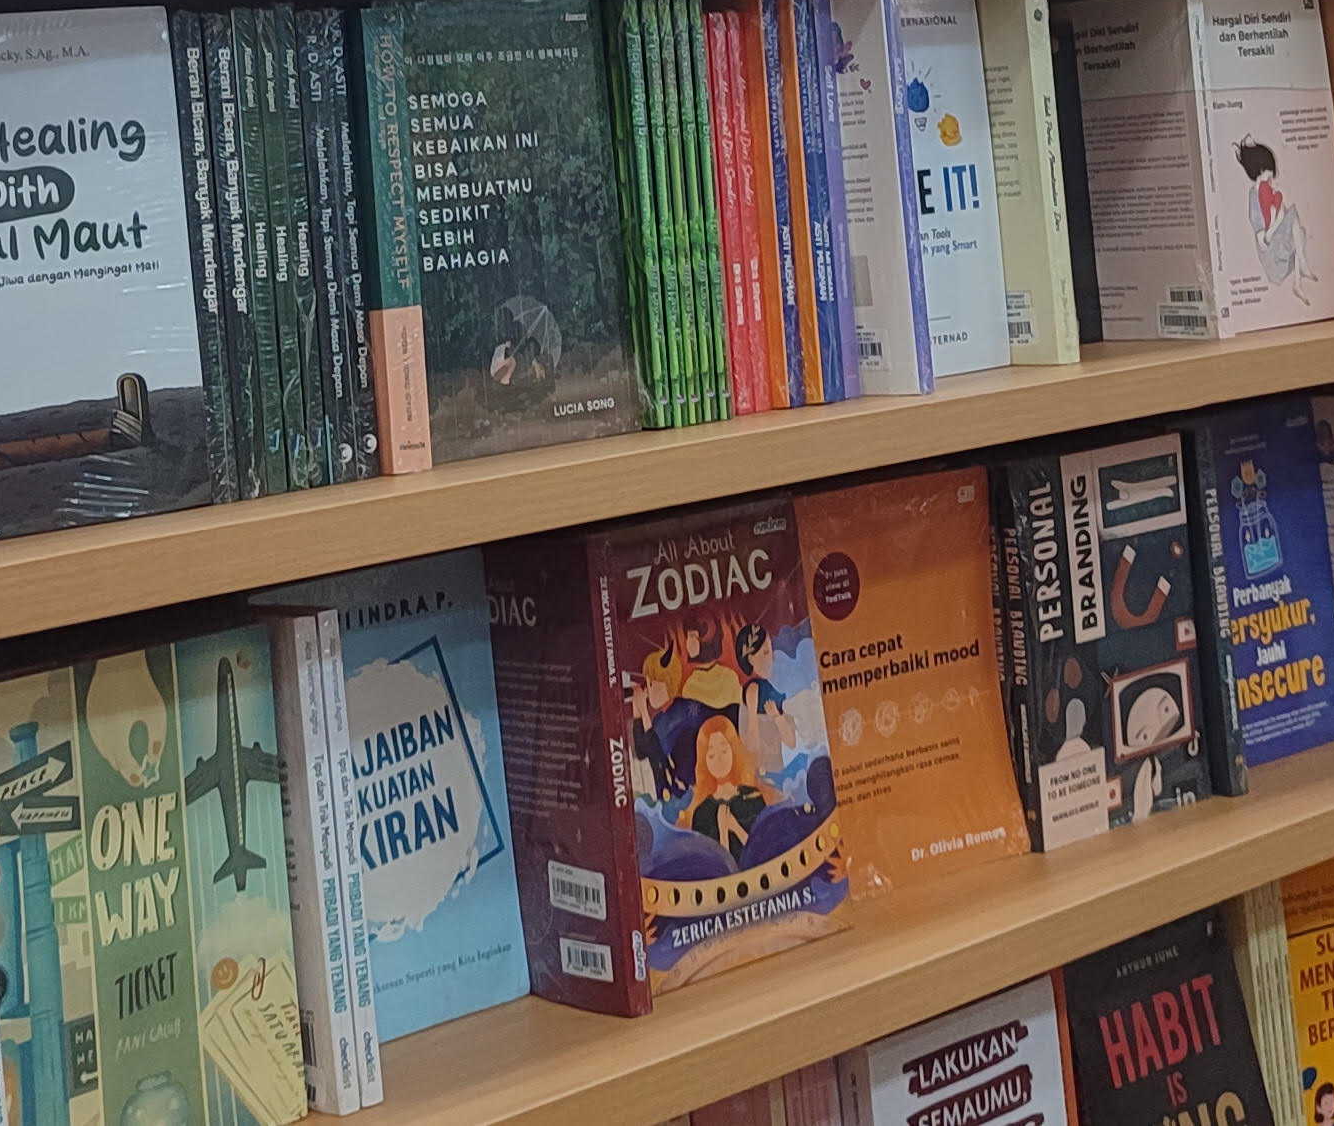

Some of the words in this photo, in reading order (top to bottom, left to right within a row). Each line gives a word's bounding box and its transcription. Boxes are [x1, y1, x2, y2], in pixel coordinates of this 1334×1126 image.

[1212, 13, 1243, 28] Hargai
[1261, 11, 1292, 24] Sendiri
[1218, 30, 1237, 42] dan
[1238, 28, 1290, 42] Berhentilah
[61, 45, 90, 59] M.A.
[1237, 45, 1276, 59] Tersakiti
[217, 47, 235, 102] Berani
[406, 90, 488, 111] SEMOGA
[409, 114, 475, 134] SEMUA
[411, 135, 508, 157] KEBAIKAN
[515, 132, 540, 149] INI
[185, 47, 202, 99] Berani
[199, 223, 219, 315] Mendengar
[225, 159, 243, 222] Banyak
[414, 161, 458, 180] BISA
[416, 177, 533, 203] MEMBUATMU
[942, 163, 980, 212] IT!
[33, 210, 148, 261] Maut
[418, 204, 491, 226] SEDIKIT
[930, 227, 952, 241] Tools
[254, 221, 268, 279] Healing
[275, 224, 289, 283] Healing
[296, 220, 311, 278] Healing
[420, 228, 476, 249] LEBIH
[422, 248, 510, 272] BAHAGIA
[952, 238, 978, 254] Smart
[27, 270, 71, 286] dengan
[73, 263, 133, 280] Mengingat
[135, 260, 160, 272] Mati
[552, 401, 584, 418] LUCIA
[585, 395, 616, 413] SONG
[683, 534, 736, 561] About
[1028, 480, 1065, 643] PERSONAL
[1070, 474, 1099, 632] BRANDING
[626, 549, 773, 619] ZODIAC
[1232, 574, 1293, 608] Perbanyak
[819, 650, 856, 669] Cara
[859, 633, 904, 659] cepat
[822, 652, 930, 695] memperbaiki
[933, 638, 981, 667] mood
[608, 736, 628, 809] ZODIAC
[90, 792, 179, 872] ONE
[94, 867, 180, 947] WAY
[322, 876, 339, 926] PRIBADI
[671, 917, 725, 948] ZERICA
[725, 894, 802, 930] ESTEFANIA
[114, 951, 179, 1021] TICKET
[1098, 973, 1222, 1090] HABIT
[917, 1026, 1020, 1090] LAKUKAN
[1165, 1070, 1190, 1108] IS
